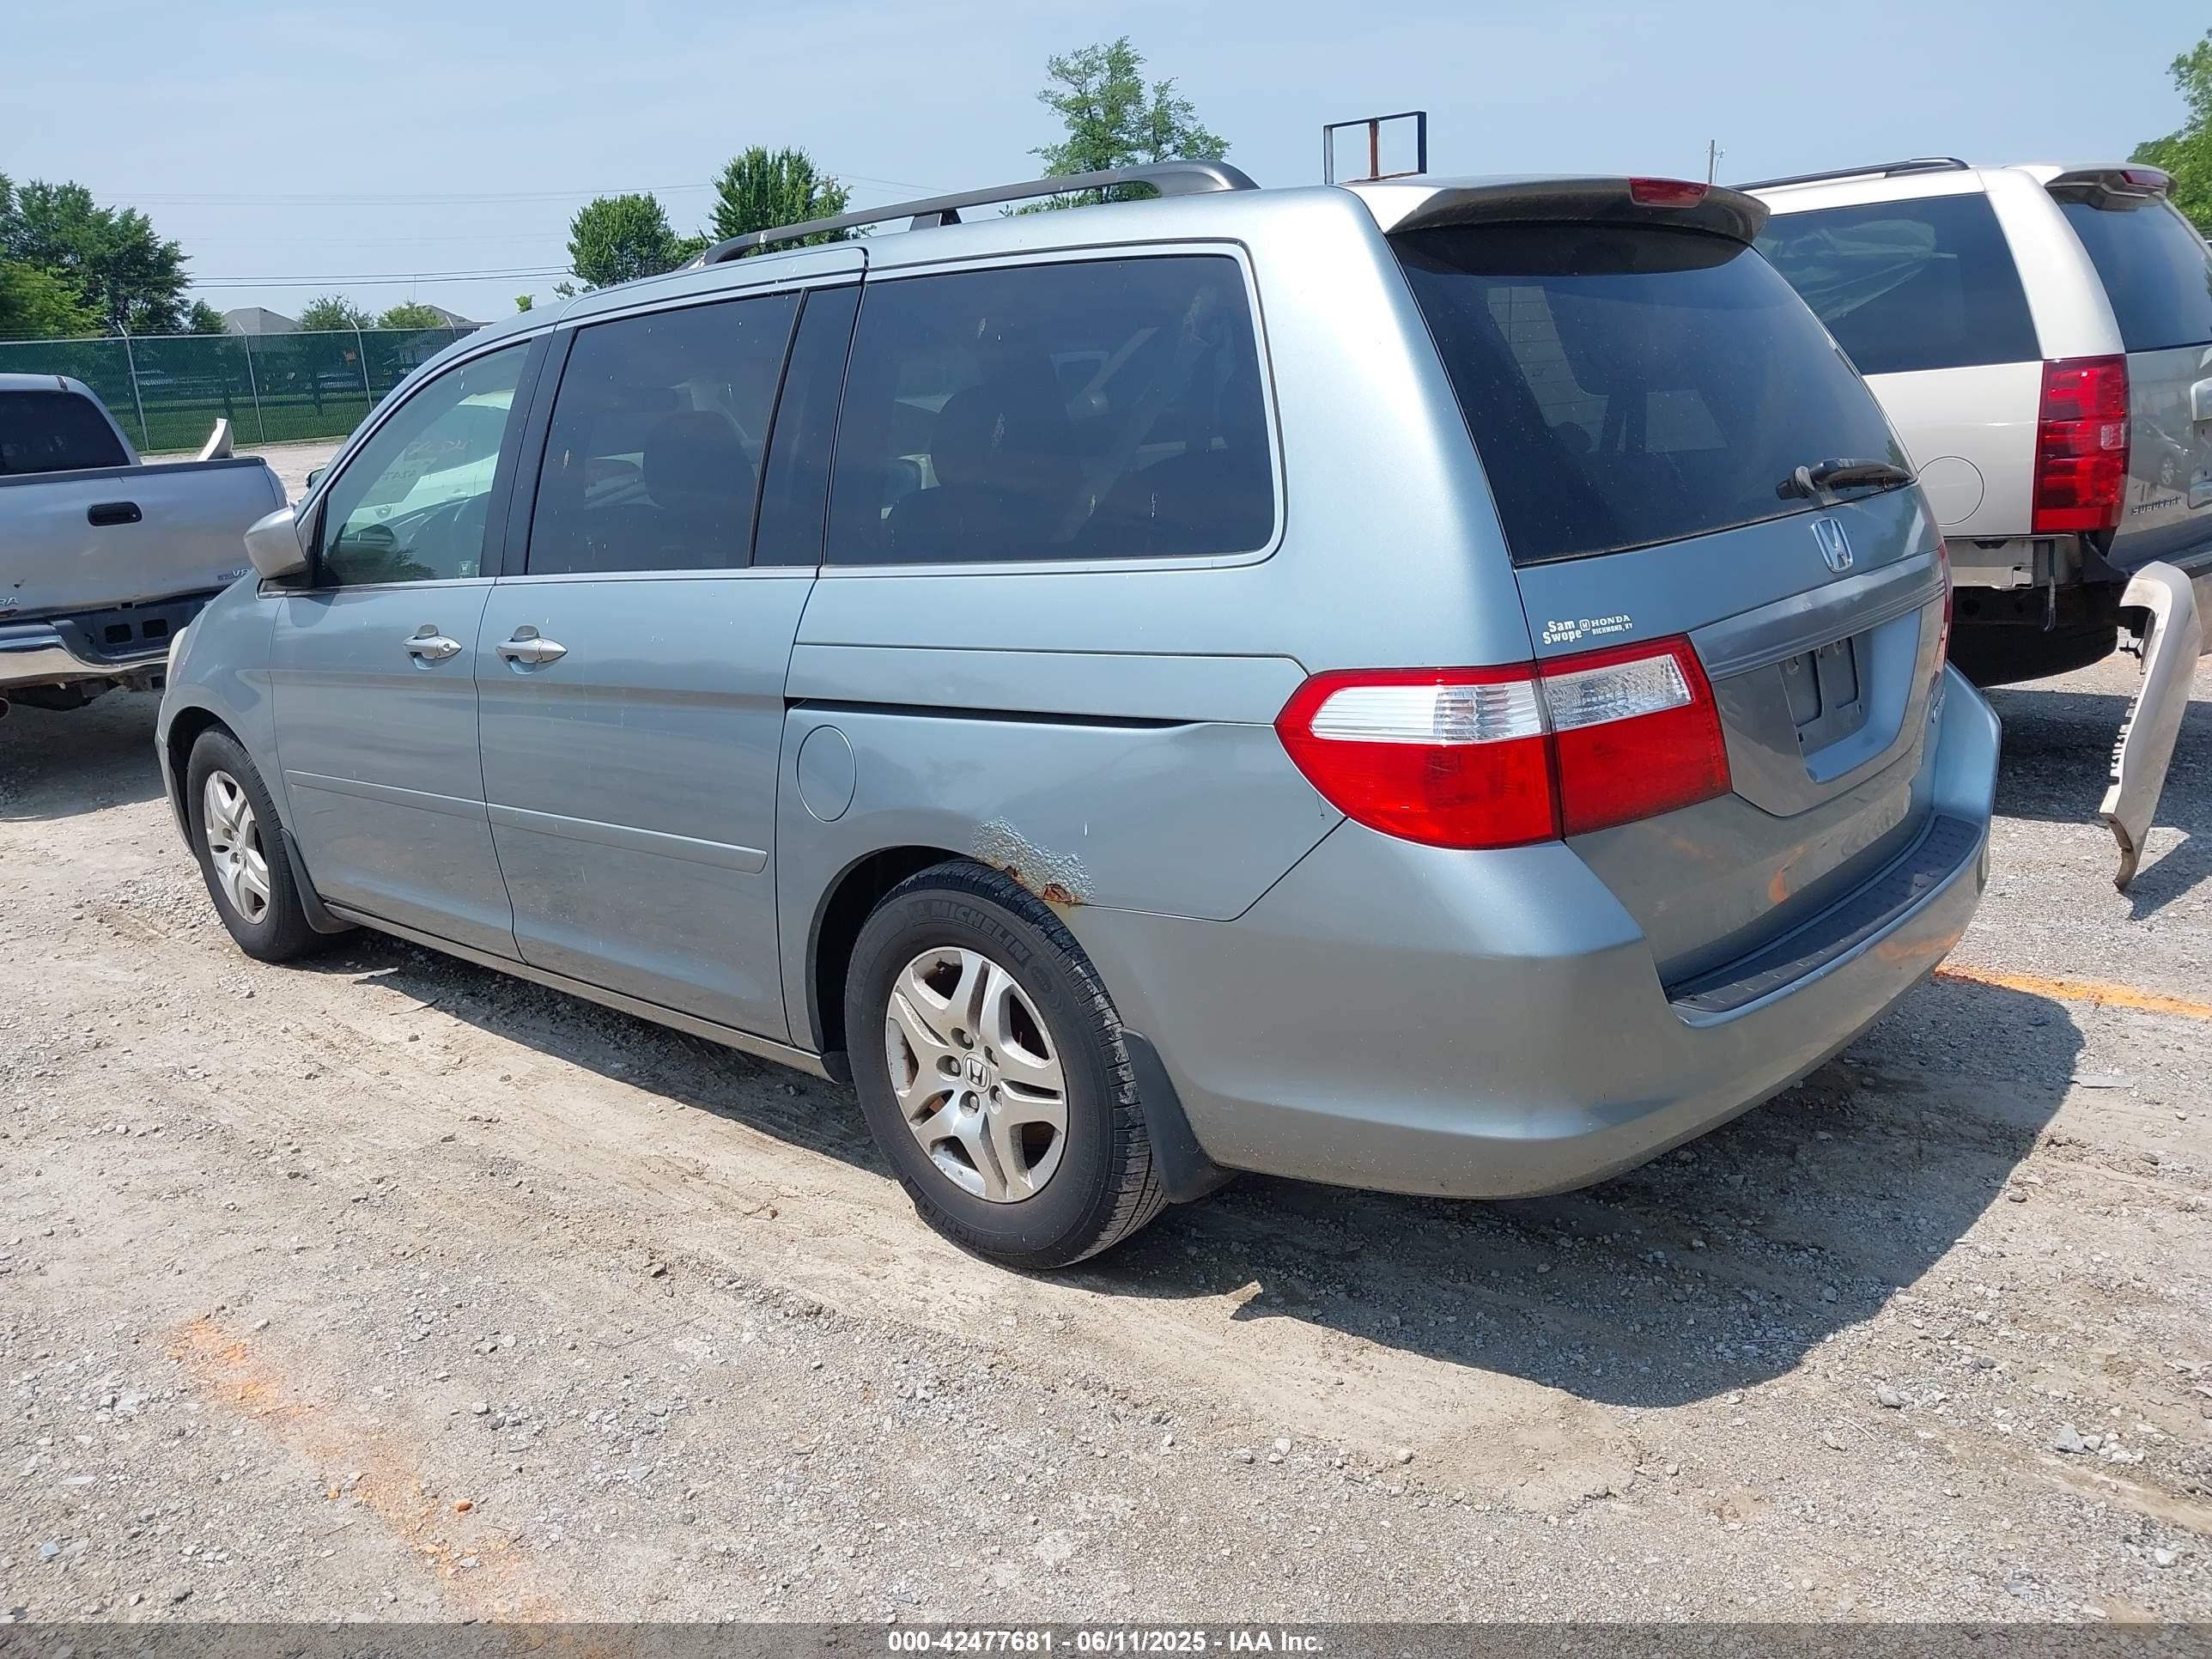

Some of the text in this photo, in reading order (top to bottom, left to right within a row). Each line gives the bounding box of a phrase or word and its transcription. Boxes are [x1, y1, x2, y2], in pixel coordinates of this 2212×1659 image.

[1547, 620, 1576, 633] Sam
[1590, 614, 1632, 628] HONDA
[1542, 629, 1583, 645] Swope
[930, 901, 1033, 966] MICHELIN
